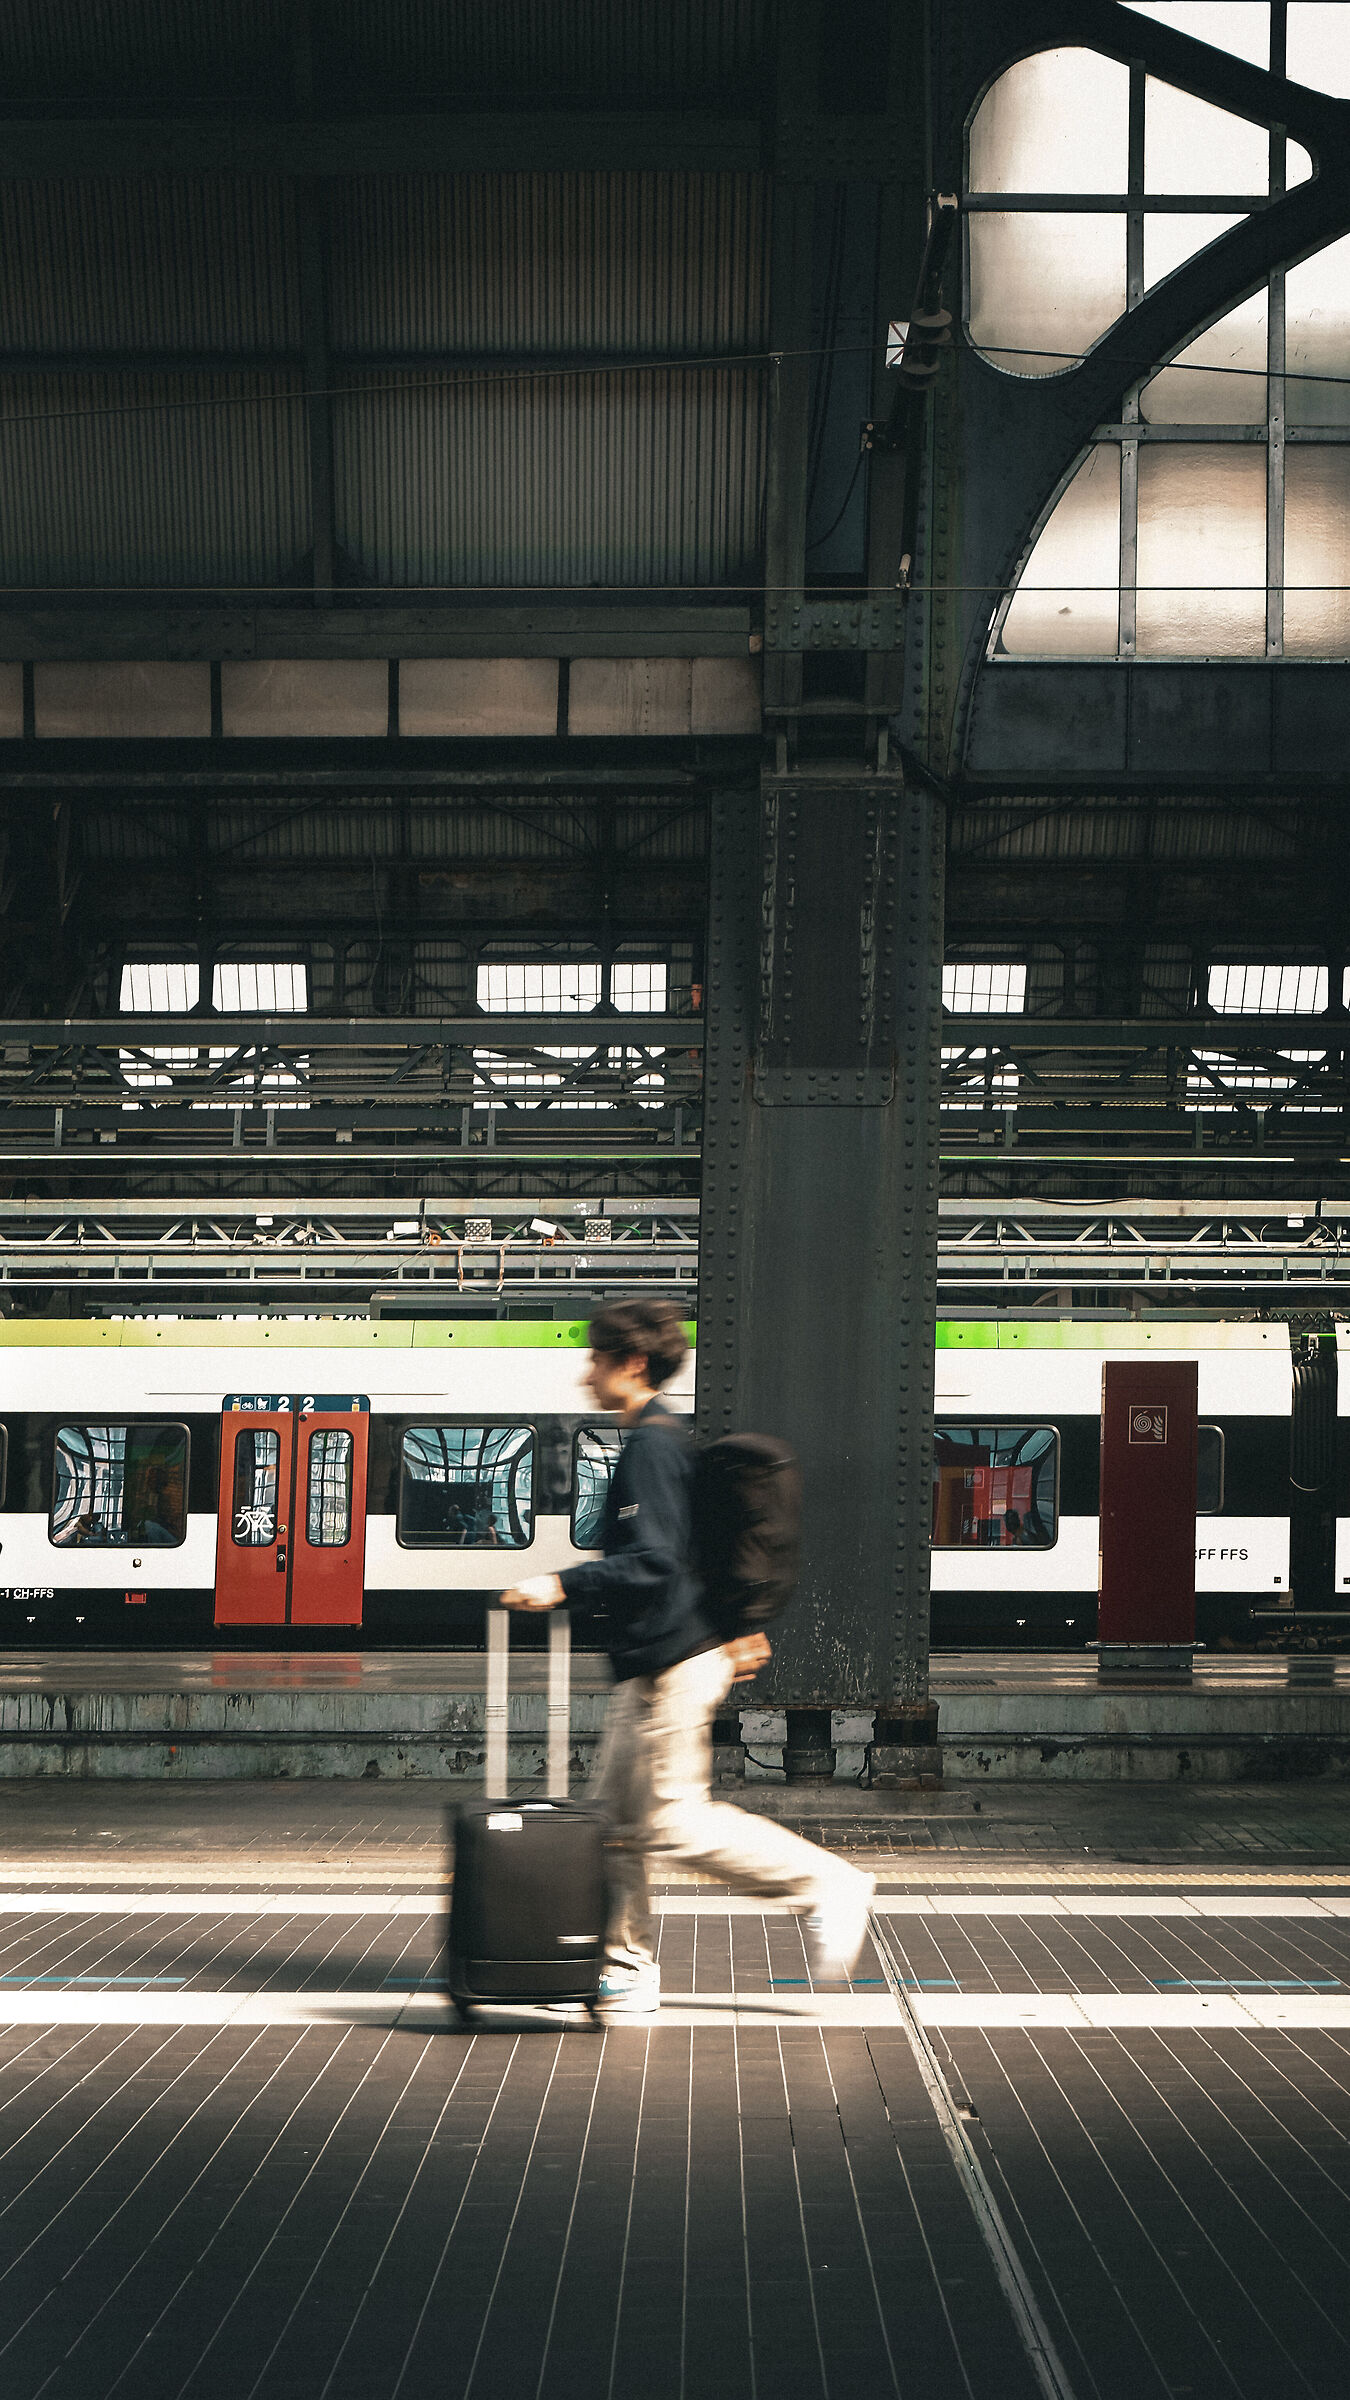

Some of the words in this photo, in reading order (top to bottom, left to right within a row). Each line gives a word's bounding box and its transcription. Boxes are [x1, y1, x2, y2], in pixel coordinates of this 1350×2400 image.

[277, 1396, 290, 1412] 2
[302, 1396, 315, 1412] 2
[1220, 1549, 1249, 1560] FFS
[13, 1588, 54, 1600] CH-FFS
